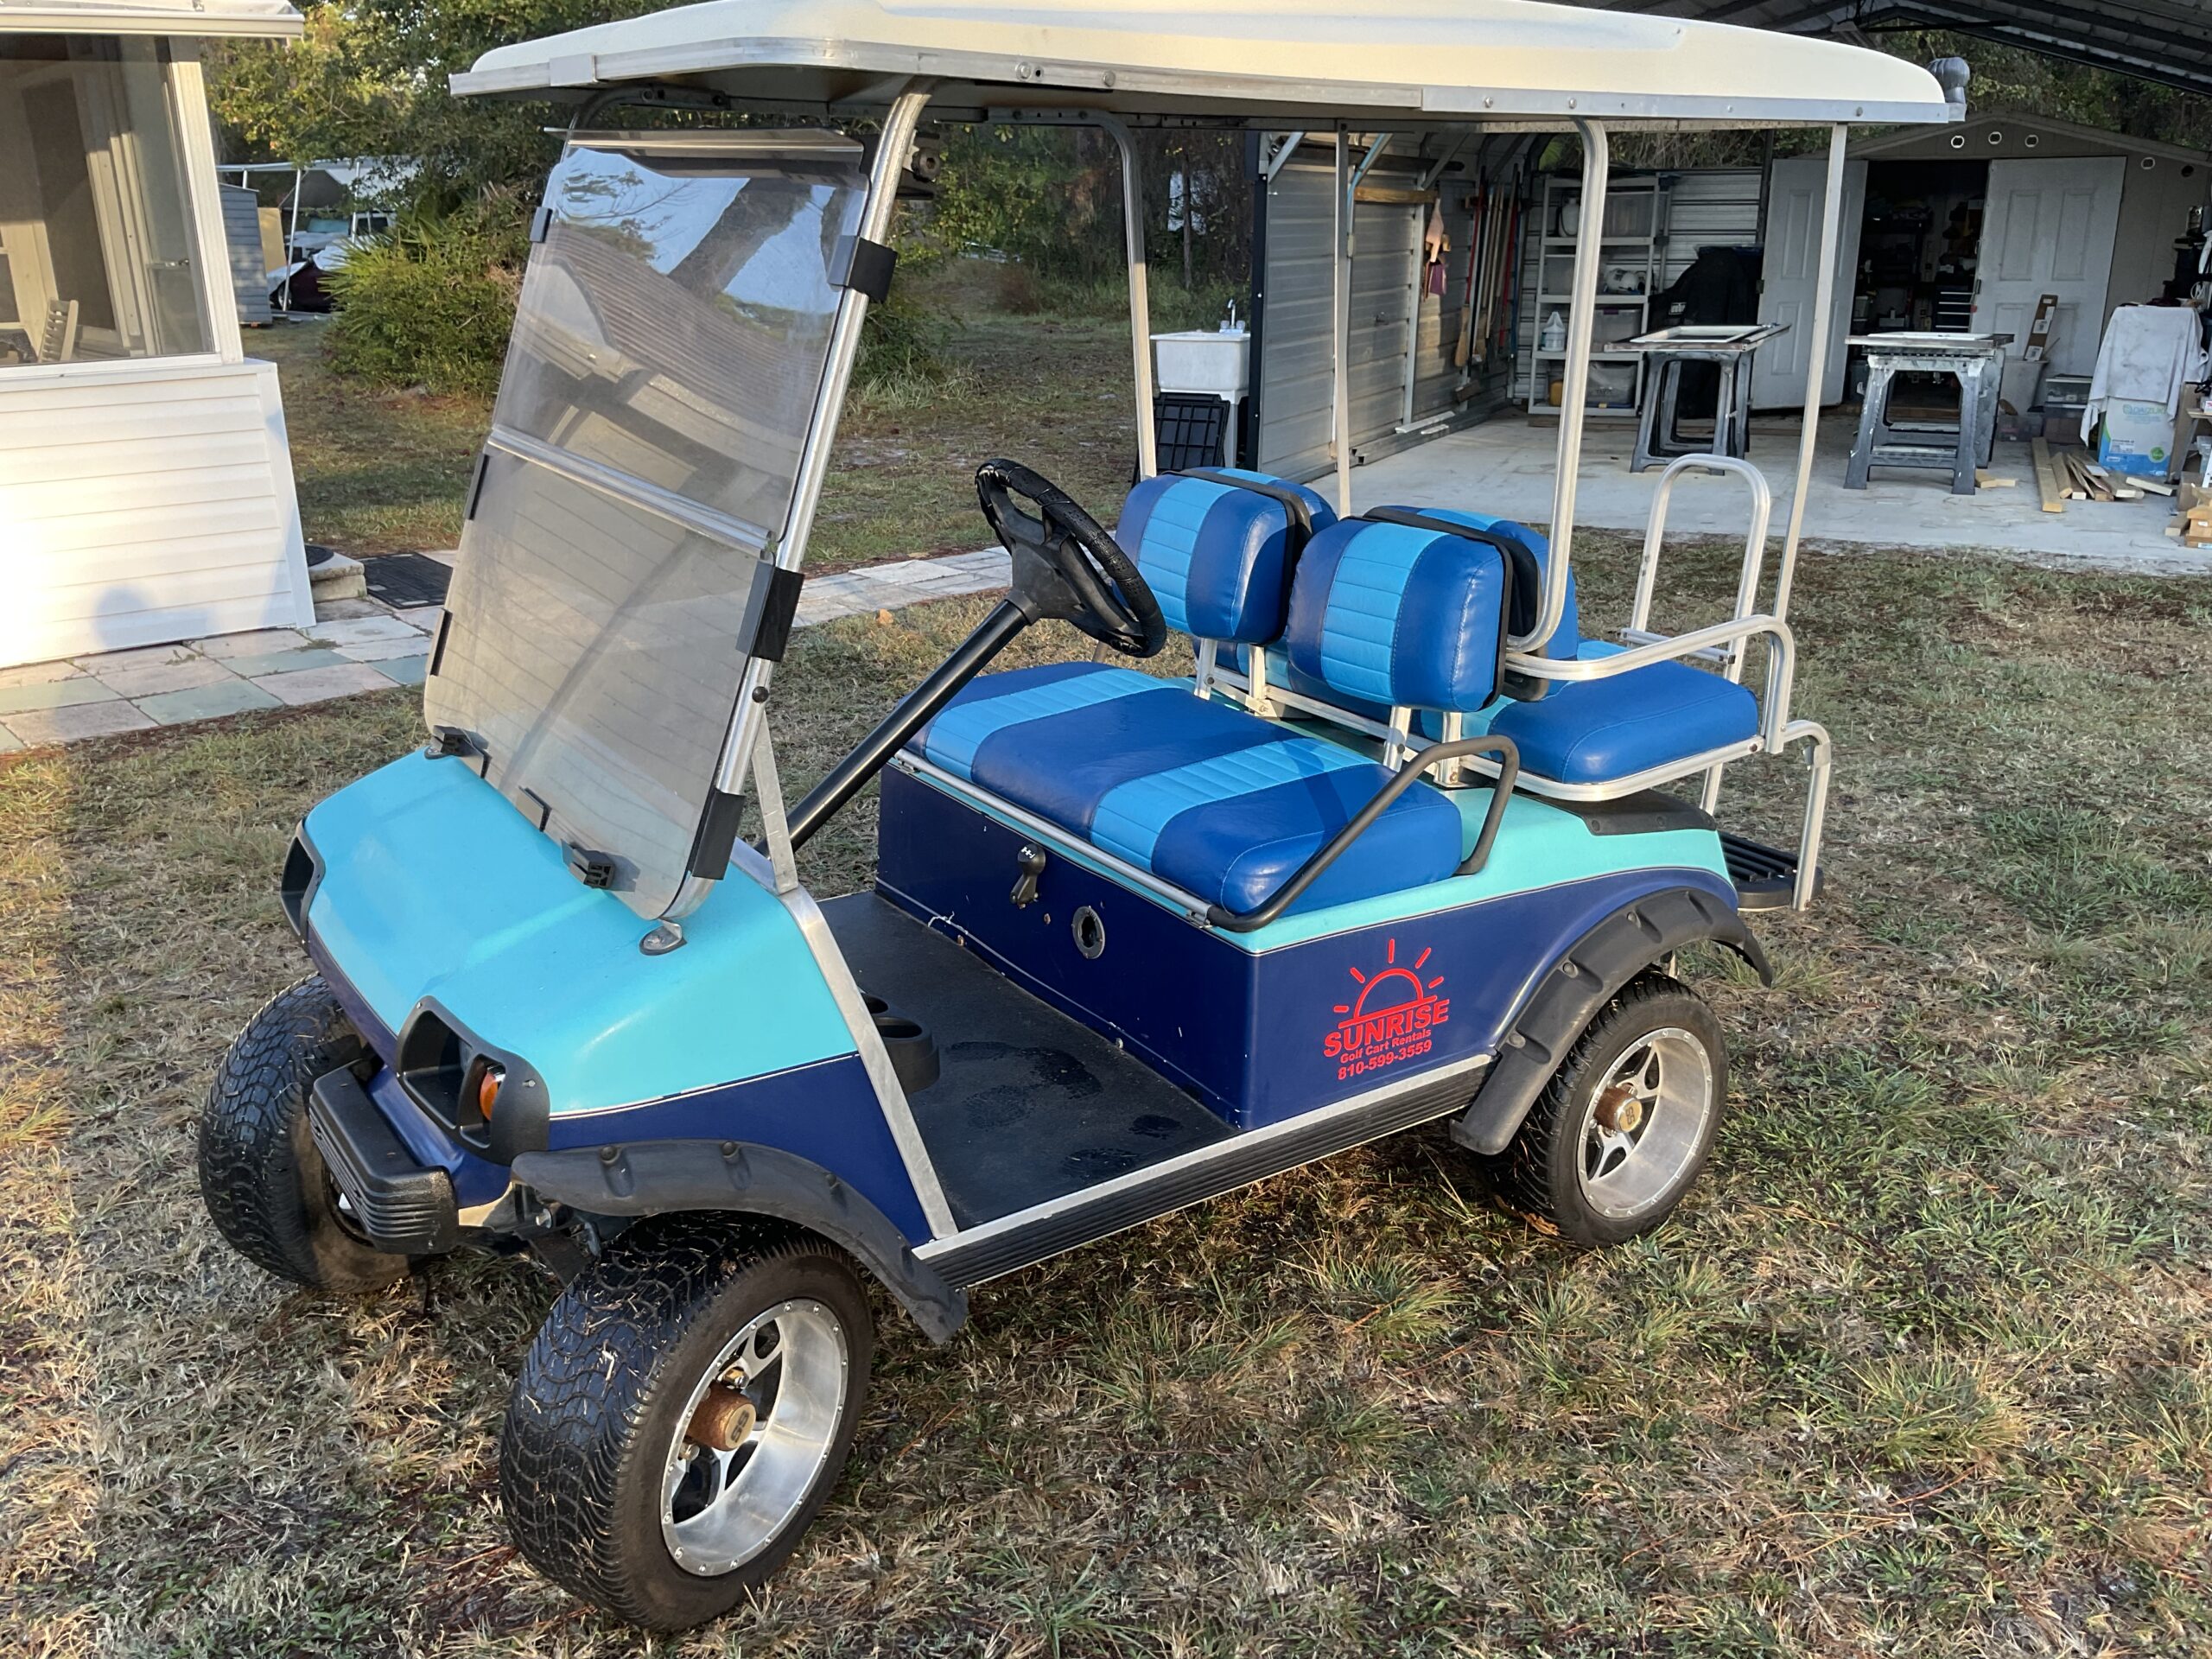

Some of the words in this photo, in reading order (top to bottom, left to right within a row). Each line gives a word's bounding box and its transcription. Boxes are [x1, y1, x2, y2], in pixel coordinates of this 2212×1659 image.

[1324, 999, 1450, 1057] SUNRISE
[1340, 1047, 1363, 1064] Golf
[1365, 1041, 1389, 1055] Cart
[1392, 1029, 1431, 1047] Rentals
[1338, 1039, 1432, 1080] 810-599-3559
